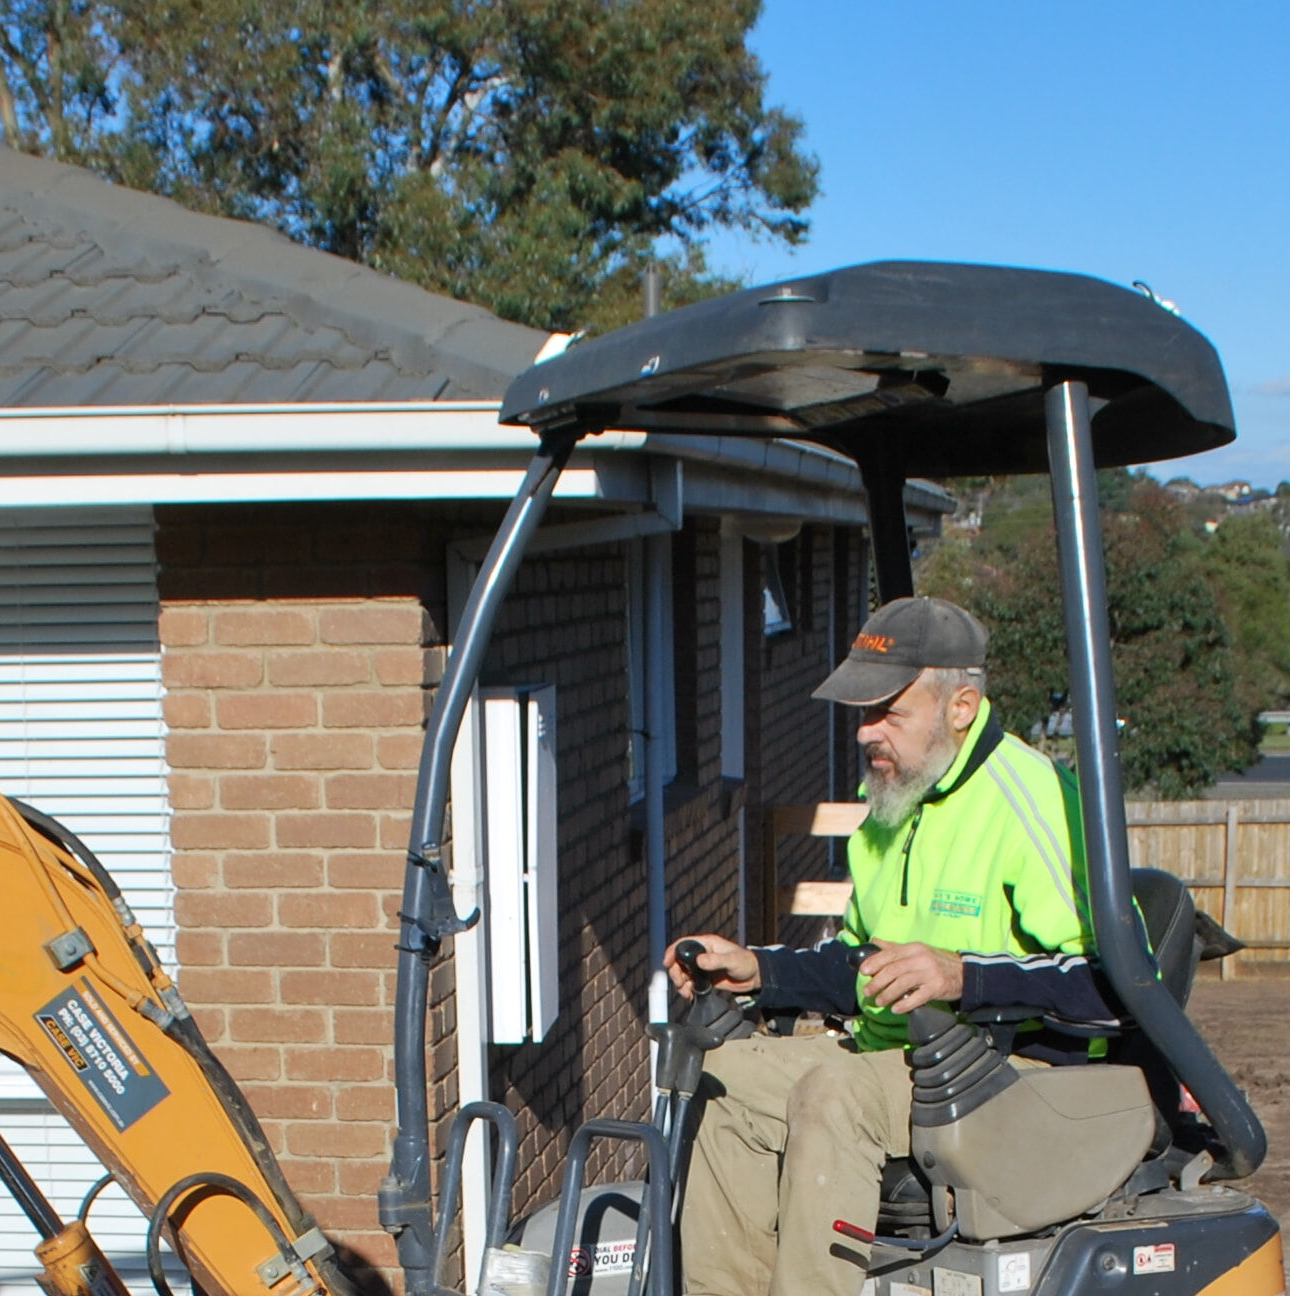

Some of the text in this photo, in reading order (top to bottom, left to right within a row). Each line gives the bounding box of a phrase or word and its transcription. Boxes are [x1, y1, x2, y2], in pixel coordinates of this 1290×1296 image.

[45, 1018, 84, 1068] CASE VIC
[67, 999, 129, 1081] CASE VICTORIA
[594, 1253, 618, 1266] YOU
